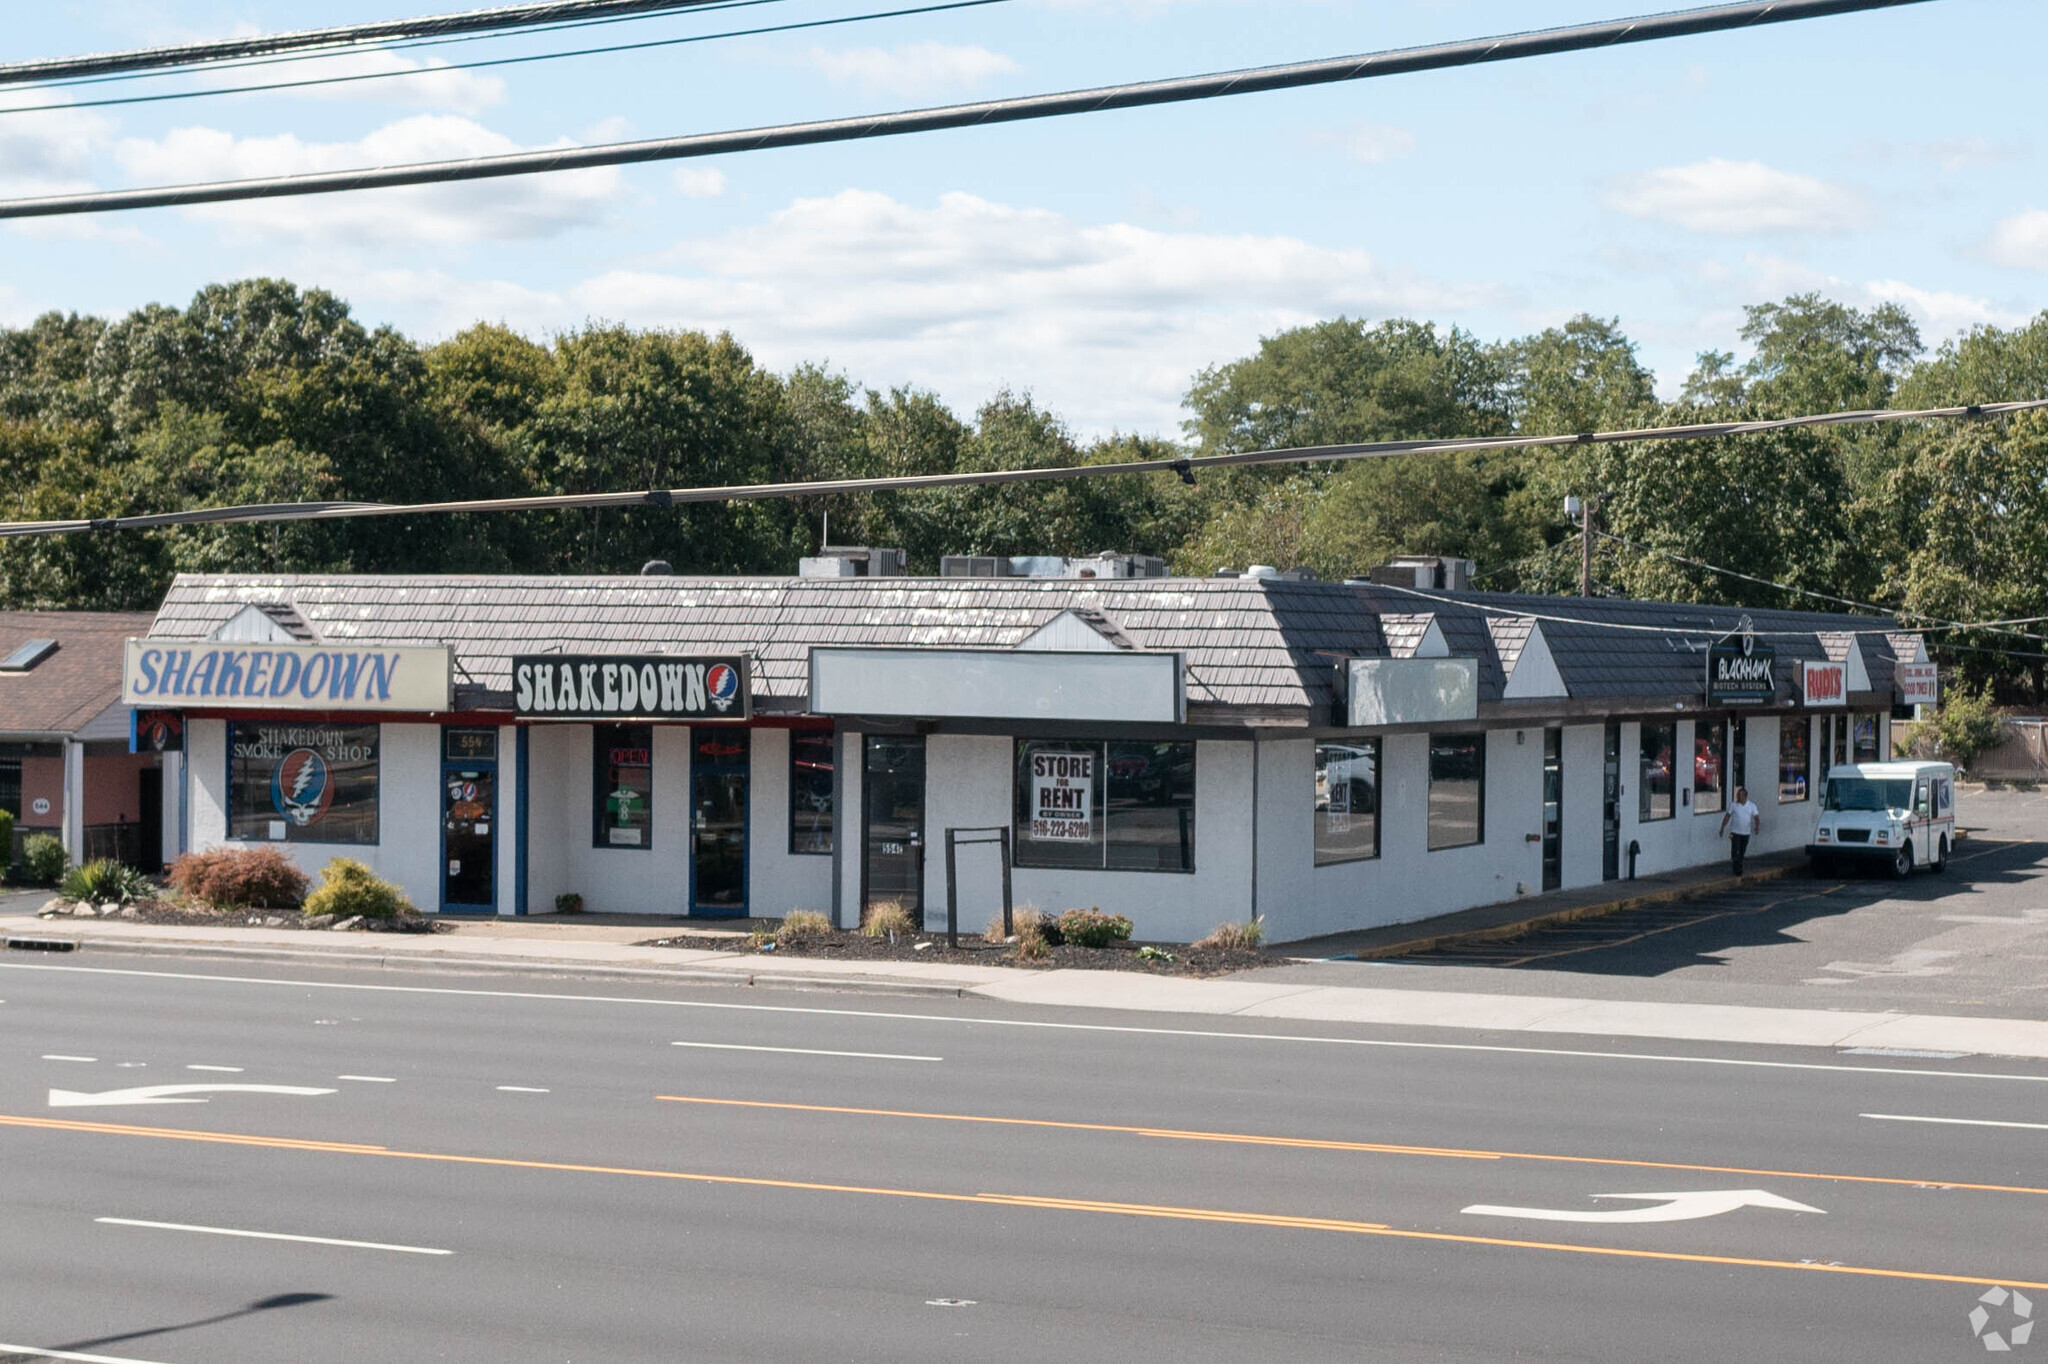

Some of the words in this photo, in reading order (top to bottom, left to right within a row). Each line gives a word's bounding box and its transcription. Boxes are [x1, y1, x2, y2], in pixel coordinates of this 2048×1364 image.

[133, 649, 400, 702] SHAKEDOWN
[1718, 657, 1775, 691] BLACKHAWK
[517, 663, 706, 712] SHAKEDOWN
[258, 728, 344, 746] SHAKEDOWN
[233, 743, 283, 759] SMOKE
[326, 746, 372, 761] SHOP
[610, 748, 648, 764] OPEN
[1034, 755, 1091, 778] STORE
[1056, 778, 1069, 787] FOR
[1040, 787, 1085, 809] RENT
[1033, 820, 1090, 838] 516-223-6200
